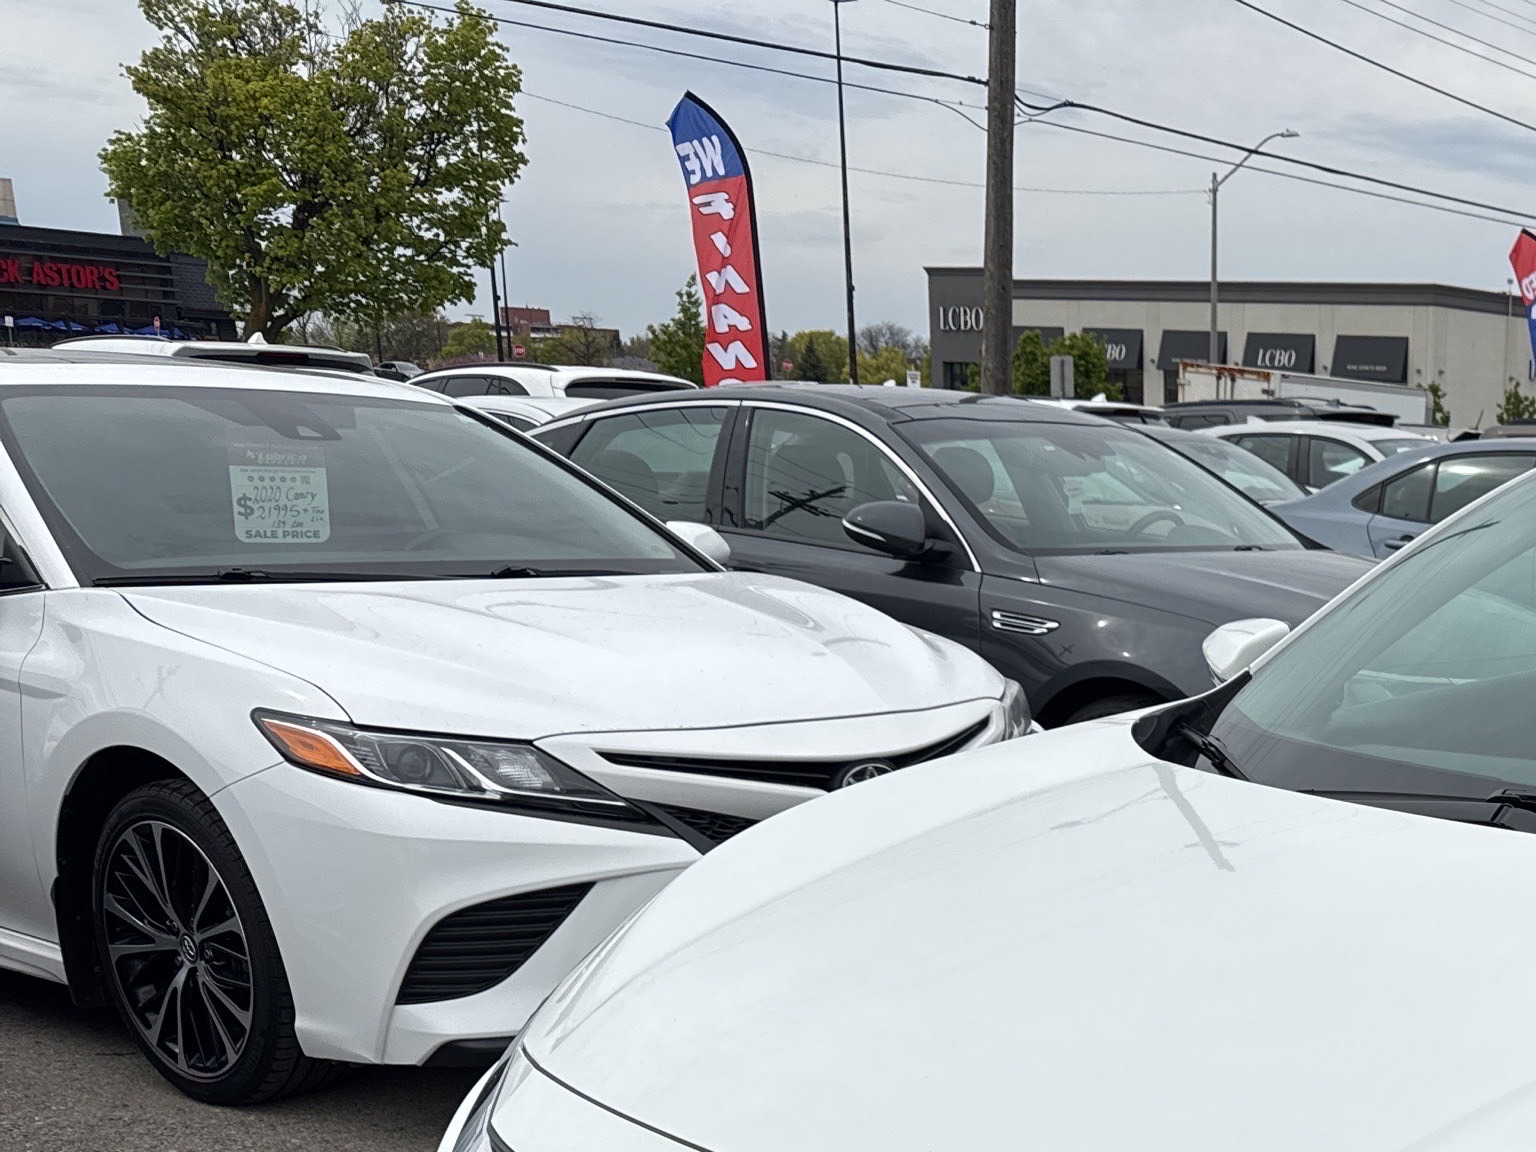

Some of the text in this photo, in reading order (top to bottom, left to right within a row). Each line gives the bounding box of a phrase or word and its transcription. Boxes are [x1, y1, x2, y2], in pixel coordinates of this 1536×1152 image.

[32, 261, 121, 291] ASTOR'S
[938, 305, 984, 331] LCBO
[1256, 347, 1297, 368] LCBO
[252, 485, 282, 504] 2020
[255, 504, 300, 520] 21995
[244, 529, 321, 539] SALE PRICE
